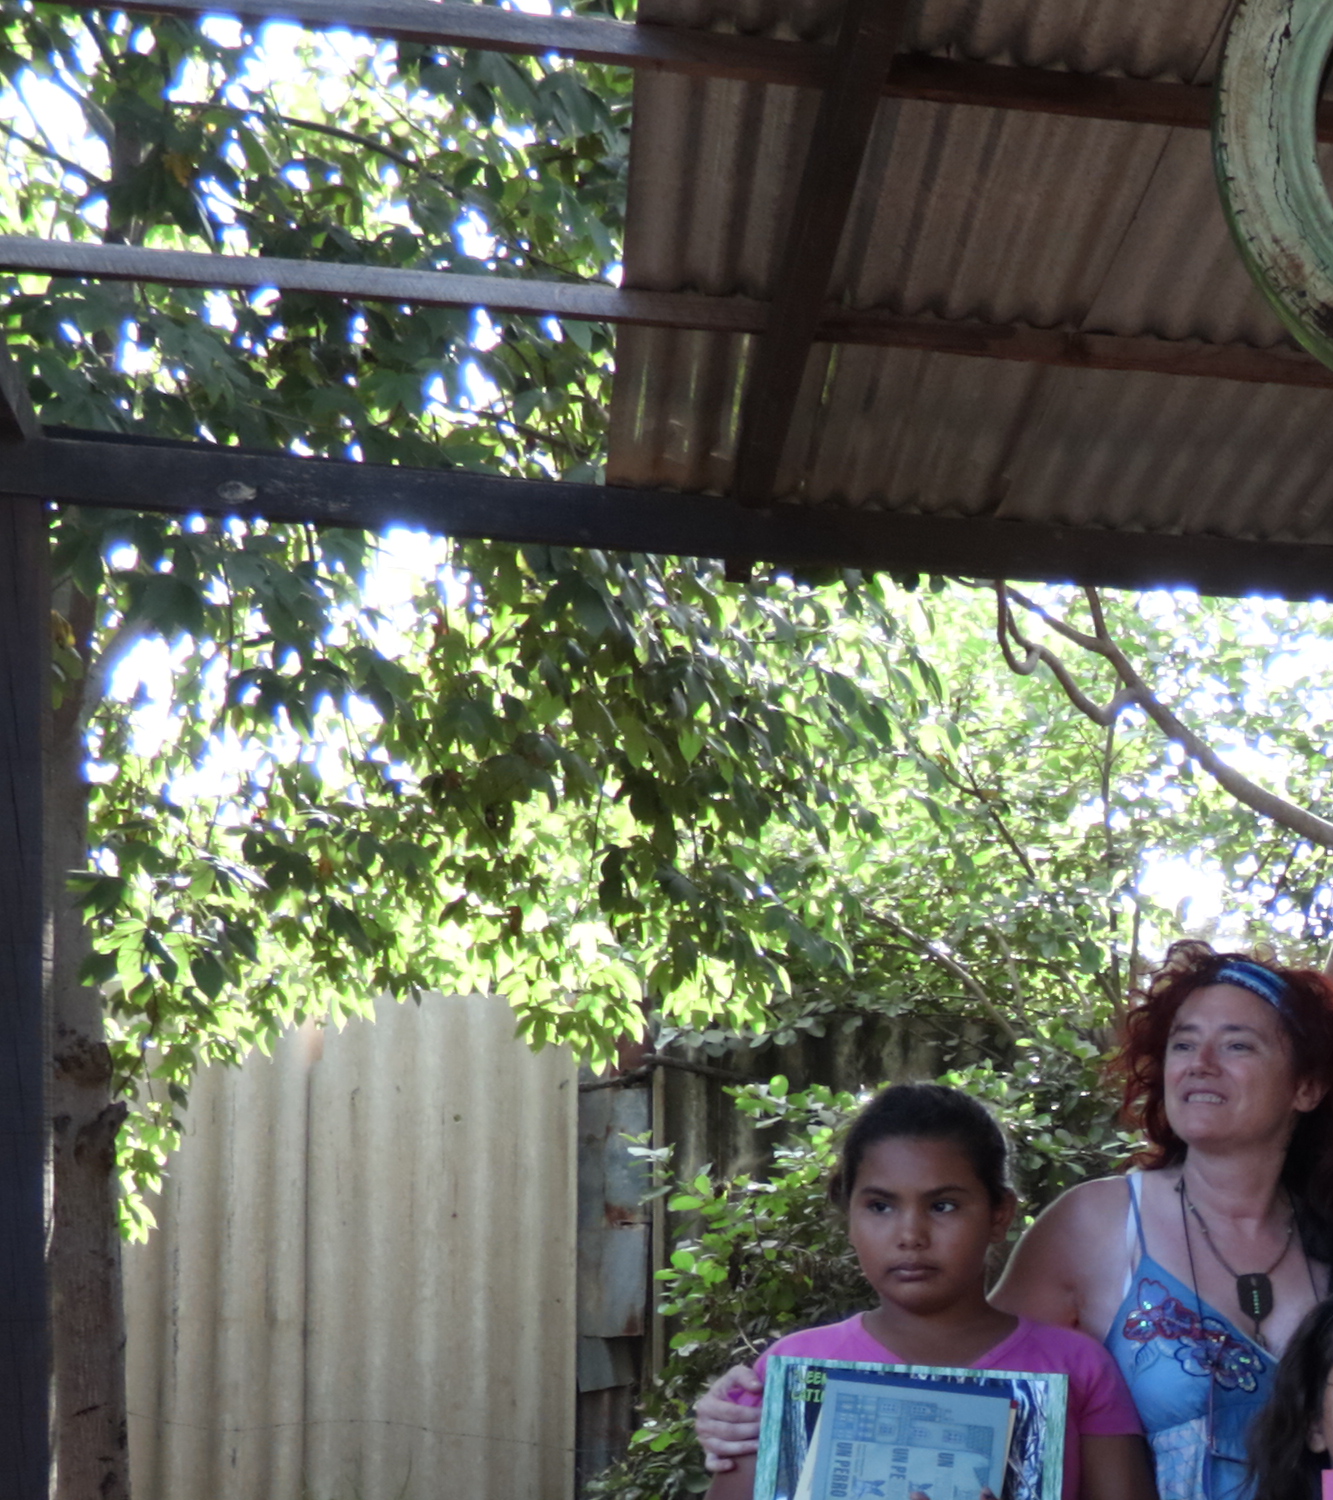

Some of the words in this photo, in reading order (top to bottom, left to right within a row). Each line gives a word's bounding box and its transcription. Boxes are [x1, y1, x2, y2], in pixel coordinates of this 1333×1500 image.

[834, 1441, 853, 1458] UN
[891, 1447, 910, 1463] UN
[937, 1452, 955, 1468] UN
[830, 1460, 852, 1497] PERRO
